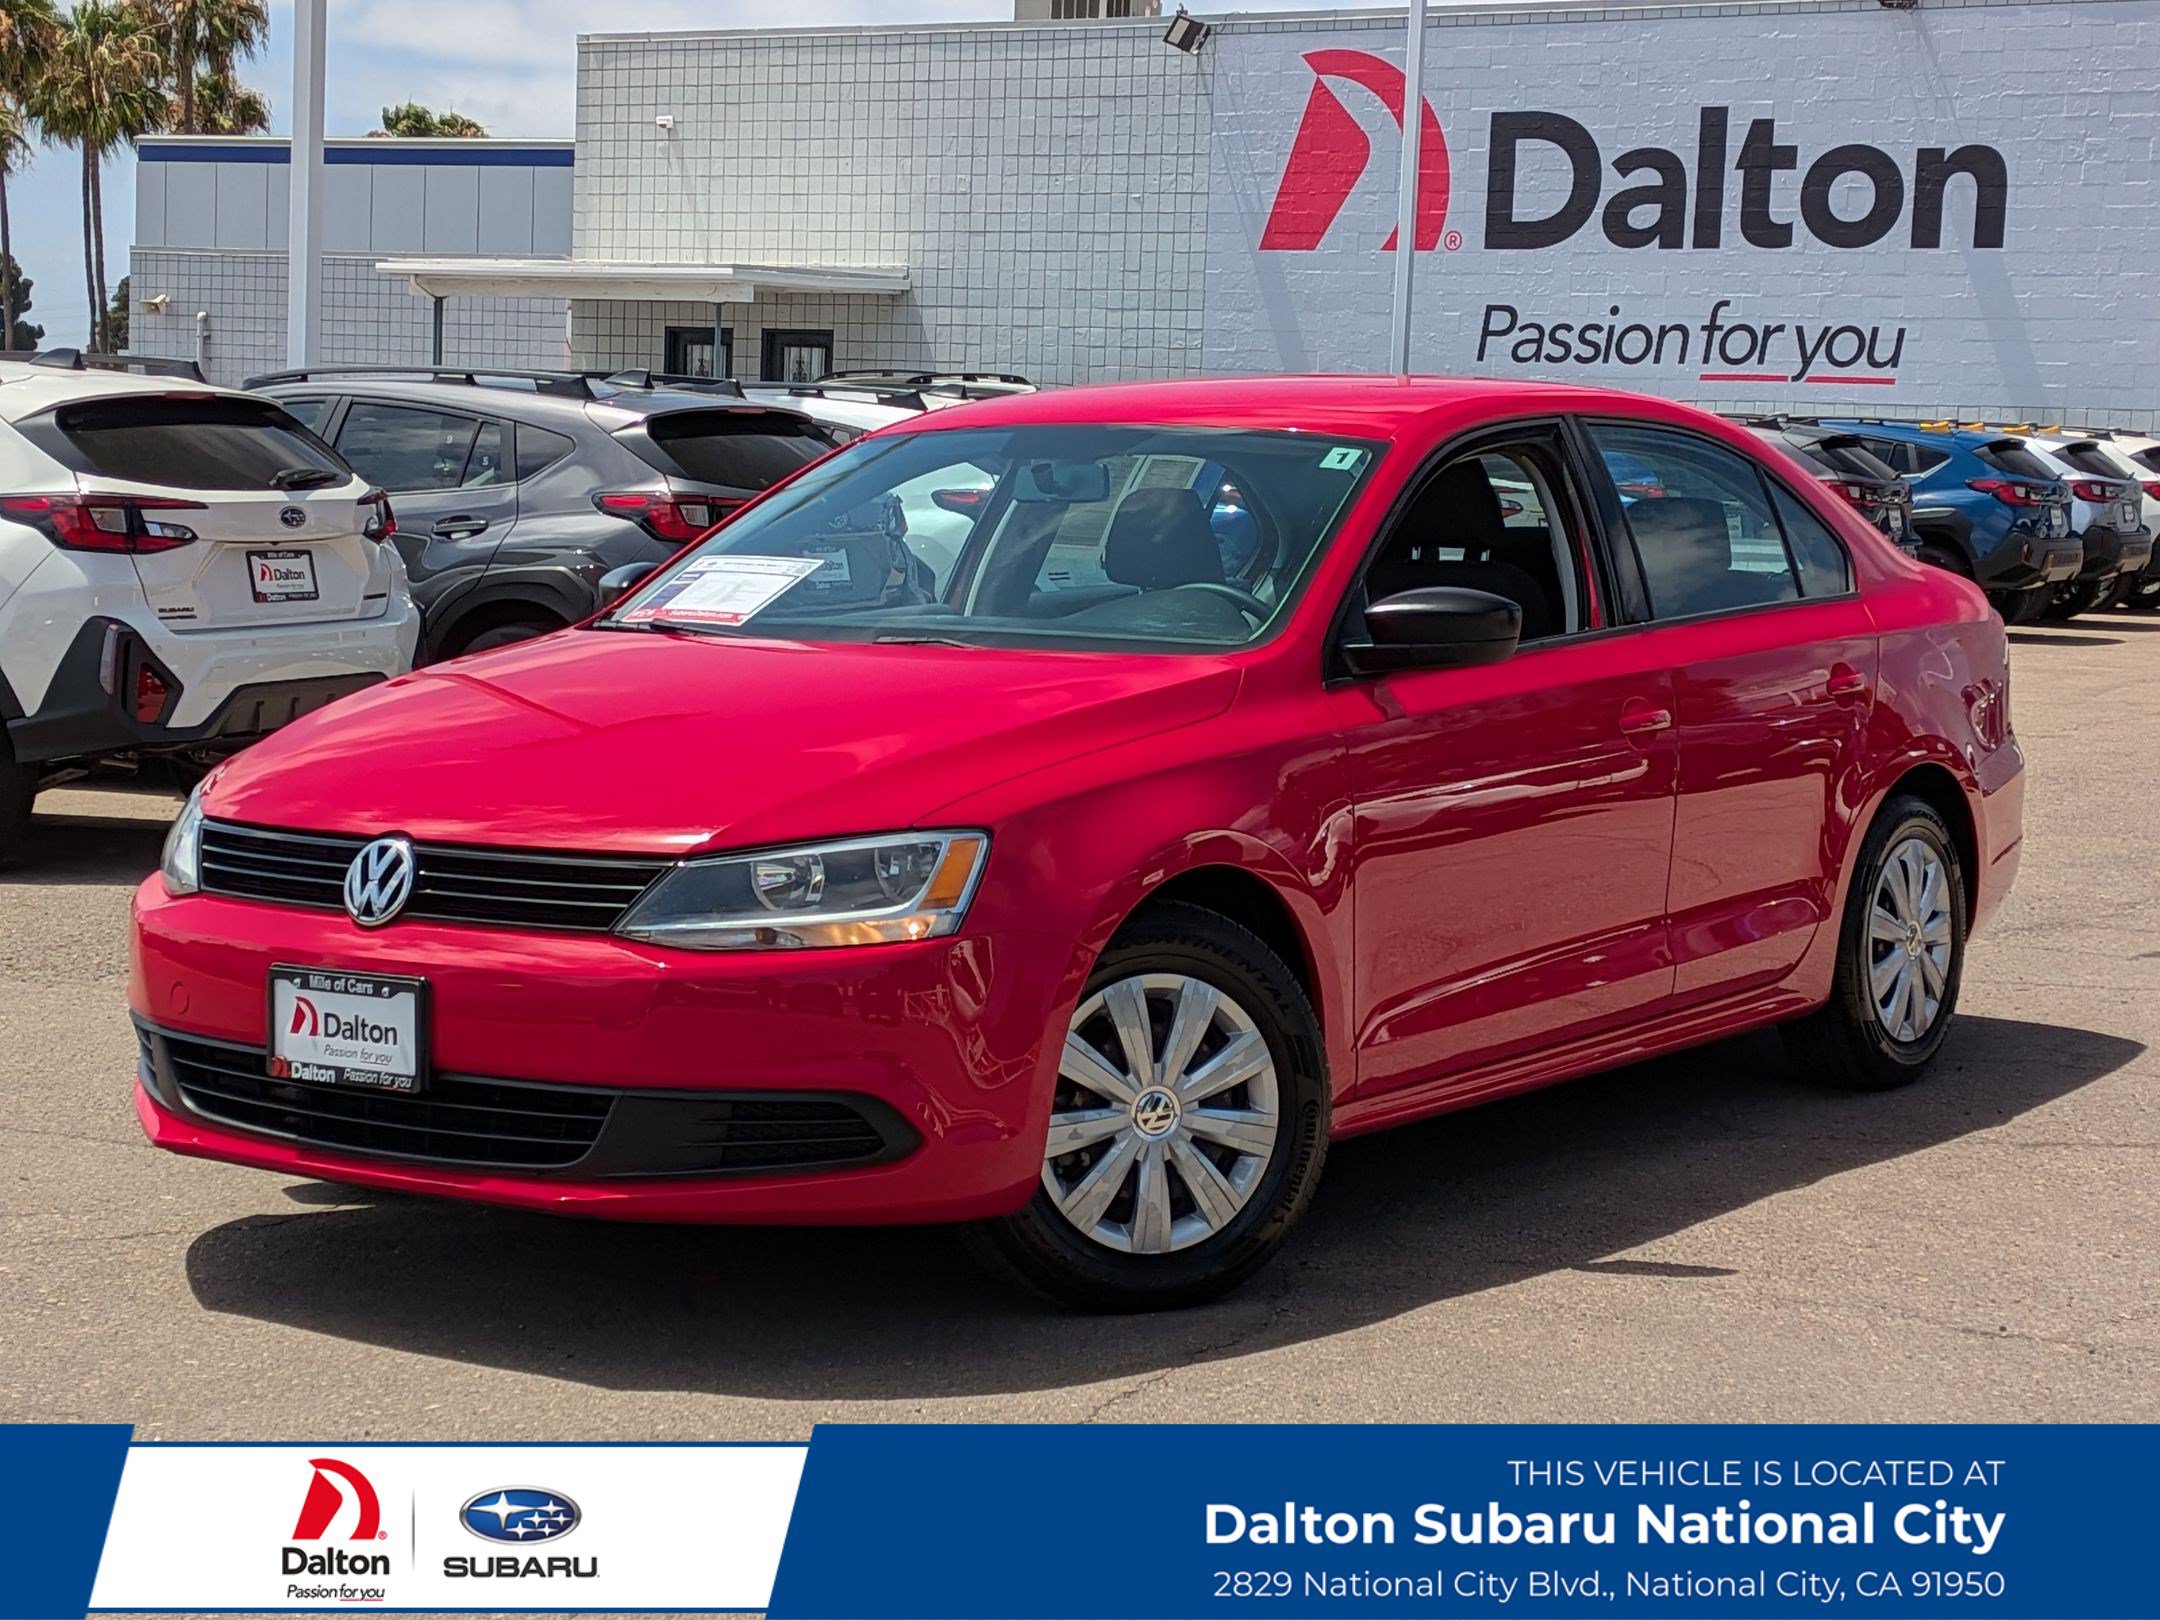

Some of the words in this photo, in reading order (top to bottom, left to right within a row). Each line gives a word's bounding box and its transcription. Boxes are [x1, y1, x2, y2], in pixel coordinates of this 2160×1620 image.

[1484, 106, 2008, 250] Dalton
[1476, 304, 1690, 366] Passion
[1698, 300, 1787, 366] for
[1791, 325, 1906, 384] you
[1336, 451, 1350, 465] 1
[273, 568, 306, 582] Dalton
[309, 974, 331, 990] Mile
[333, 978, 345, 991] of
[347, 978, 374, 994] Cars
[323, 1012, 398, 1046] Dalton
[323, 1044, 358, 1060] Passion
[358, 1048, 373, 1062] for
[374, 1052, 393, 1065] you
[291, 1062, 336, 1083] Dalton
[343, 1068, 378, 1084] Passion
[378, 1072, 393, 1086] for
[393, 1076, 413, 1089] you
